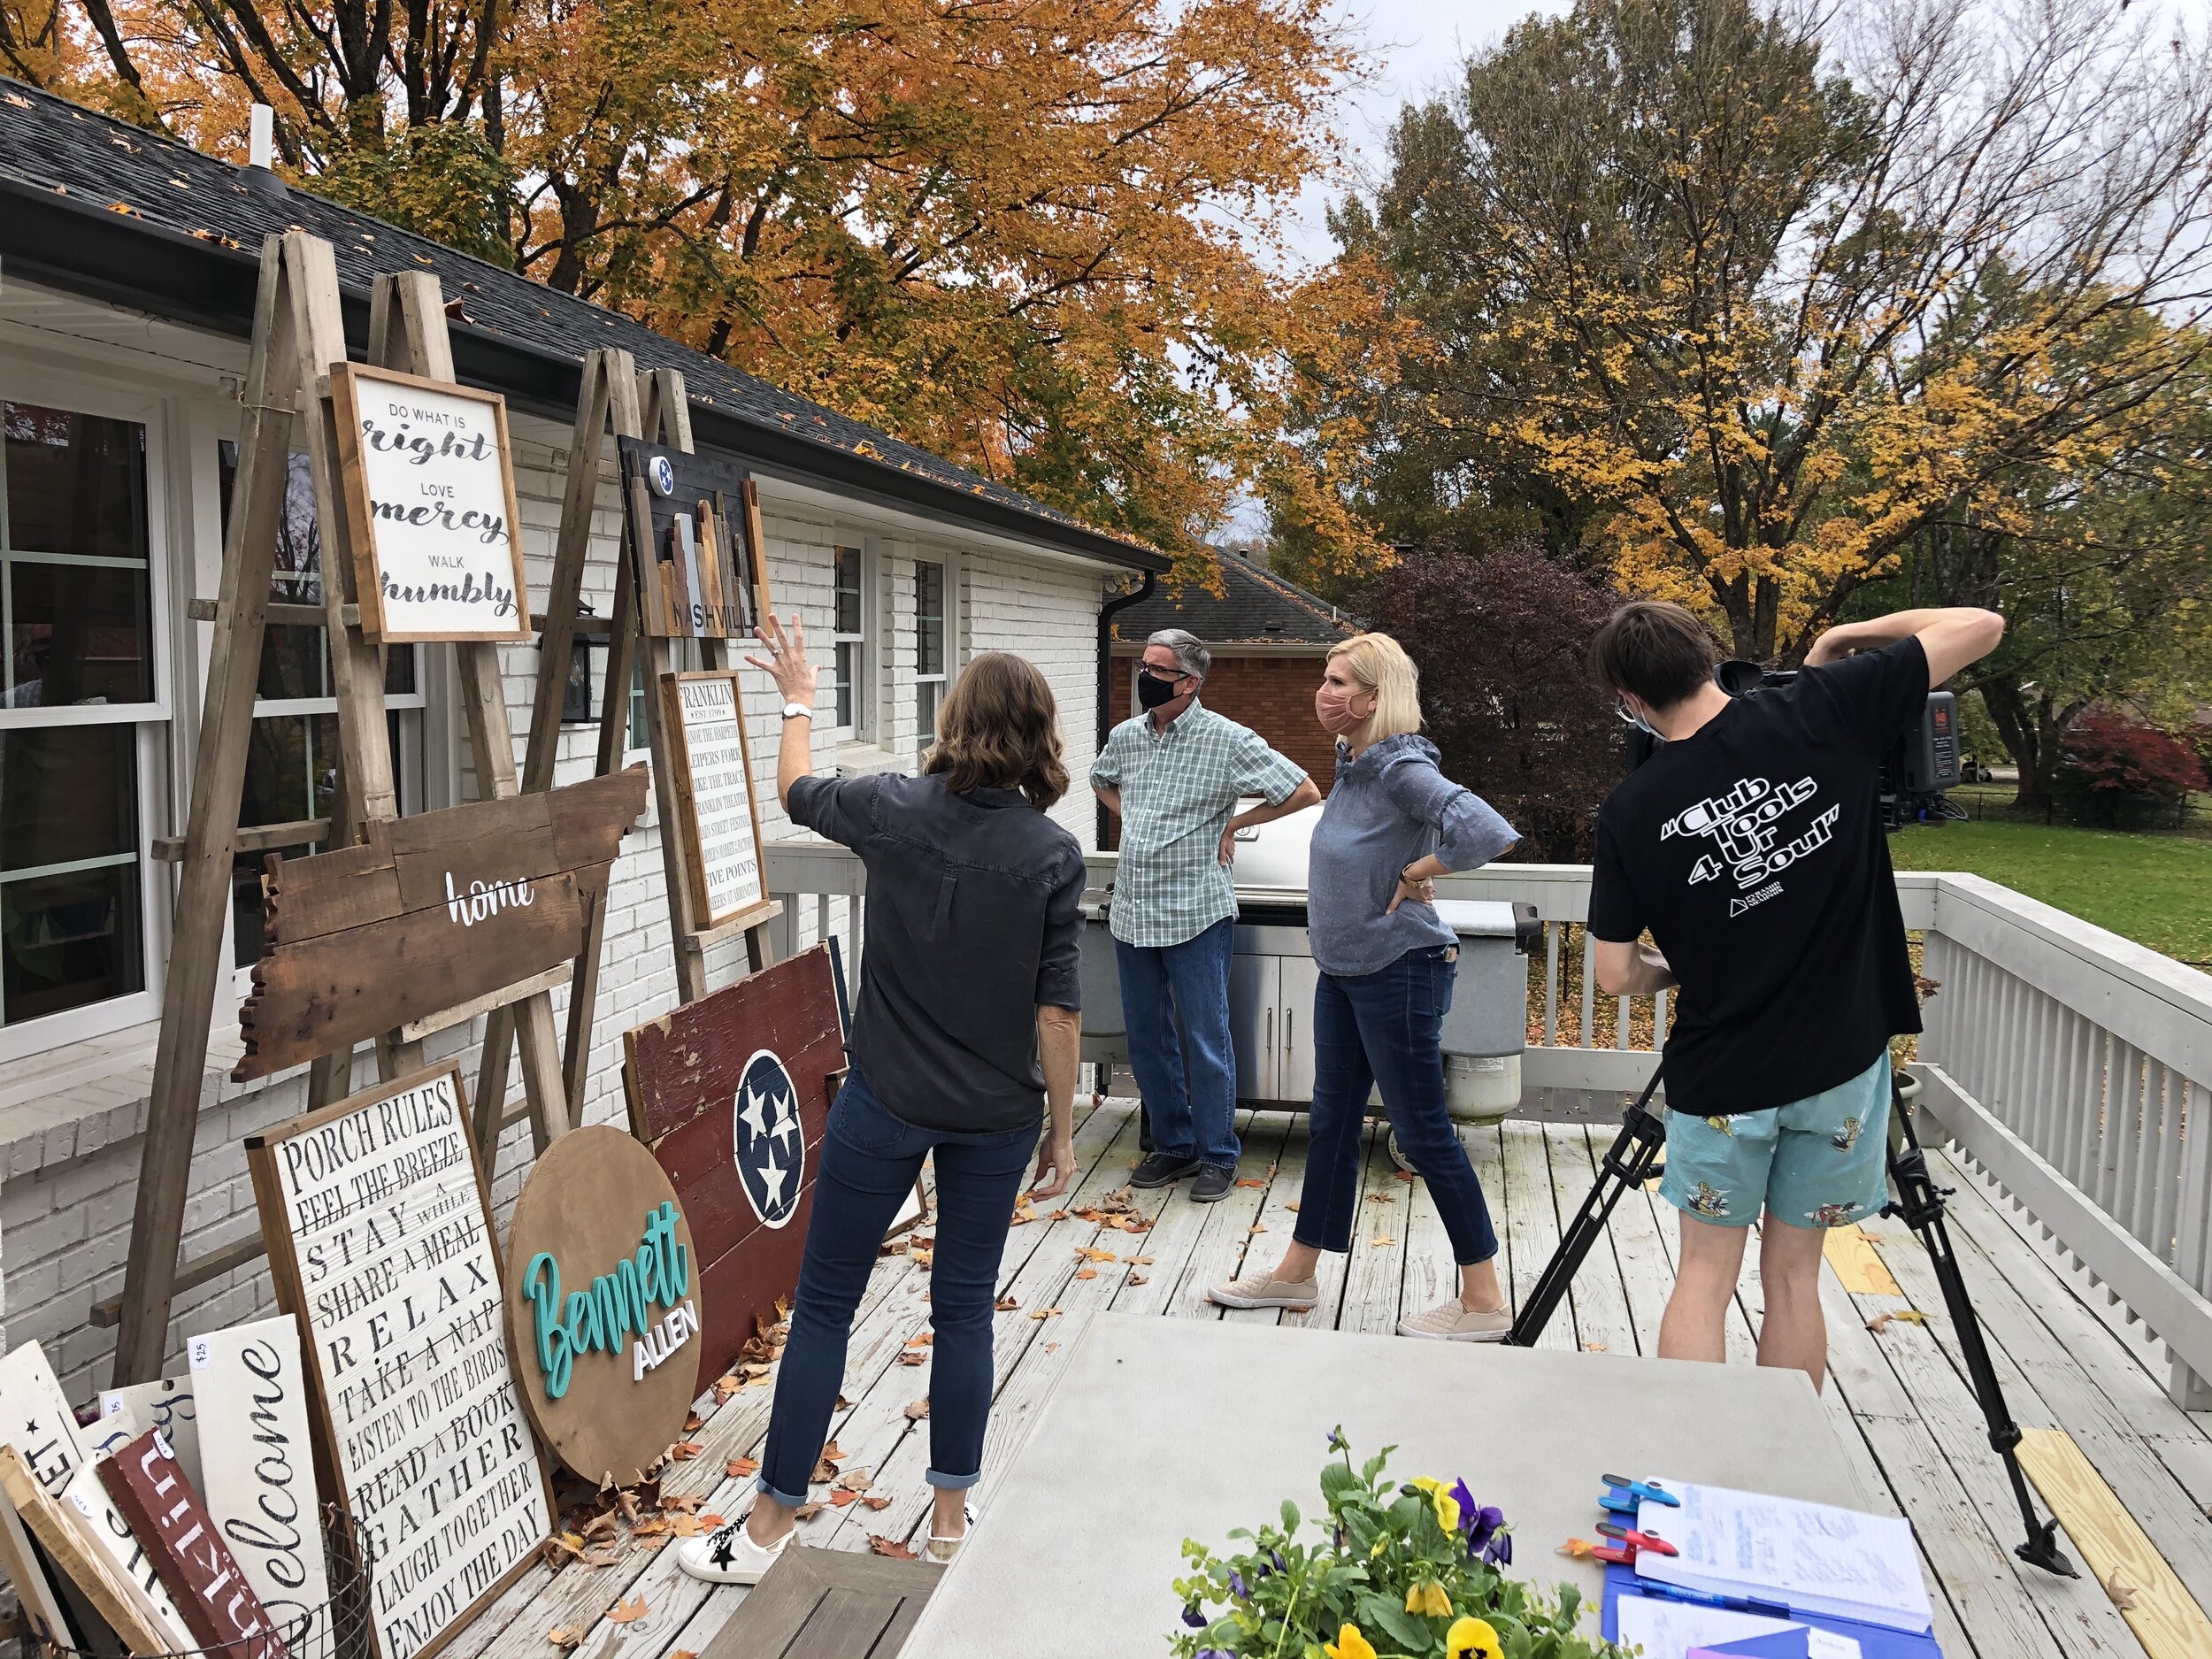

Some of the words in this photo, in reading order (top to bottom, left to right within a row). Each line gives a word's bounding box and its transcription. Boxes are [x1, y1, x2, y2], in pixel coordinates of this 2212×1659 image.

[389, 403, 408, 418] DO
[412, 408, 449, 426] WHAT
[455, 417, 465, 428] IS
[362, 419, 500, 465] right
[420, 483, 455, 498] LOVE
[371, 501, 510, 545] mercy
[428, 555, 465, 569] WALK
[380, 572, 518, 618] humbly
[687, 728, 703, 744] ANOE
[702, 727, 714, 742] THE
[695, 710, 707, 719] EST
[709, 709, 722, 718] 1799
[721, 748, 741, 764] FORK
[708, 774, 723, 789] THE
[723, 770, 745, 787] TRACE
[695, 797, 723, 816] RANKLIN
[1700, 776, 1818, 847] Tools
[726, 858, 757, 881] POINTS
[1687, 854, 1724, 886] 4
[1721, 826, 1778, 865] Ur
[445, 871, 534, 927] home
[710, 892, 726, 910] HEERS
[1745, 881, 1780, 900] PYRAMID
[1747, 886, 1782, 903] NETWORK
[1748, 888, 1784, 907] MEMPHIS
[282, 1109, 376, 1196] PORCH
[377, 1080, 453, 1146] RULES
[296, 1185, 351, 1238] FEEL
[350, 1164, 394, 1210] THE
[396, 1131, 465, 1191] BREEZE
[435, 1182, 447, 1197] A
[417, 1190, 471, 1226] WHILE
[306, 1201, 408, 1283] STAY
[317, 1258, 399, 1330] SHARE
[405, 1248, 417, 1274] A
[421, 1214, 480, 1272] MEAL
[327, 1255, 488, 1378] RELAX
[523, 1201, 688, 1400] Bennett
[196, 1342, 208, 1363] $25
[338, 1350, 413, 1425] TAKE
[426, 1336, 441, 1371] A
[448, 1298, 495, 1355] NAP
[634, 1299, 700, 1382] ALLEN
[346, 1408, 407, 1473] LISTEN
[406, 1388, 430, 1430] TO
[430, 1365, 463, 1413] THE
[465, 1337, 507, 1393] BIRDS
[356, 1446, 427, 1523] READ
[434, 1432, 447, 1459] A
[450, 1384, 516, 1452] BOOK
[365, 1421, 523, 1563] GATHER
[376, 1535, 442, 1616] LAUGH
[441, 1461, 533, 1558] TOGETHER
[385, 1577, 459, 1659] ENJOY
[459, 1545, 503, 1601] THE
[501, 1497, 541, 1564] DAY
